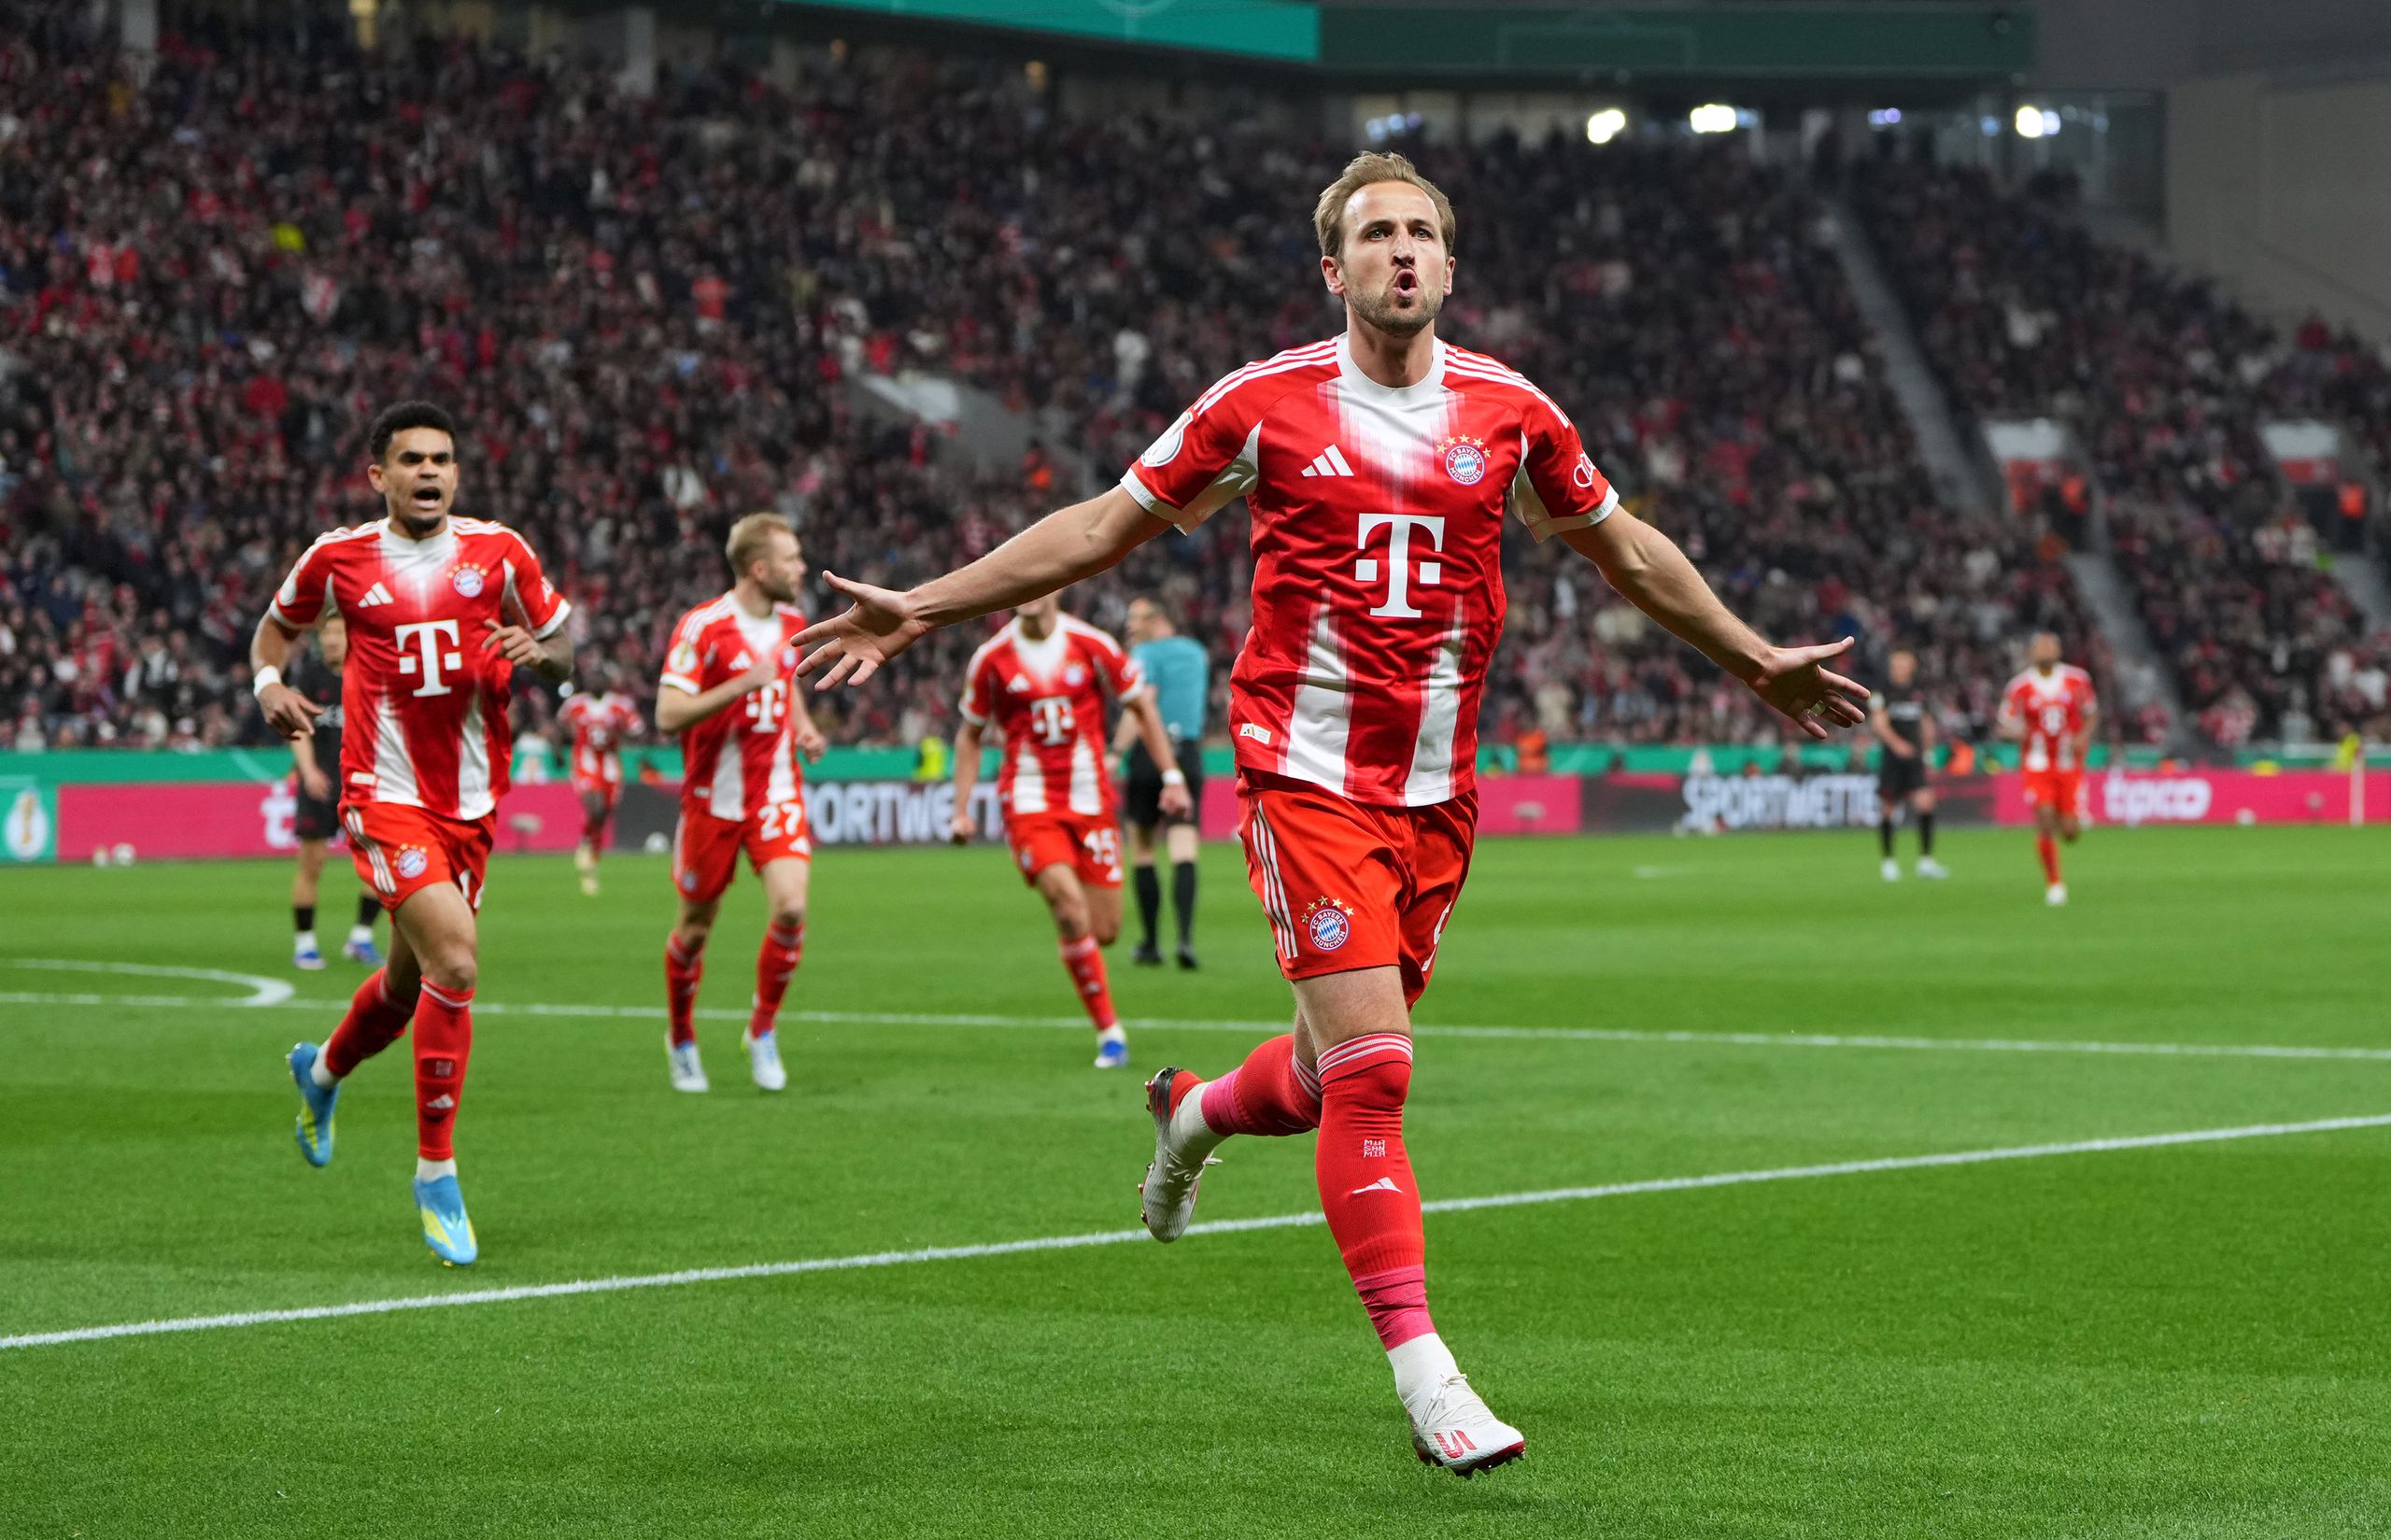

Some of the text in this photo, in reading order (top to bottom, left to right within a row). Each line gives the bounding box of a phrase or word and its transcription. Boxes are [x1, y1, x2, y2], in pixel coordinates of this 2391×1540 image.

[1456, 447, 1481, 464] BAYERN
[1355, 513, 1445, 618] T
[395, 619, 462, 698] T
[758, 802, 803, 841] 27
[1317, 911, 1344, 925] BAYERN
